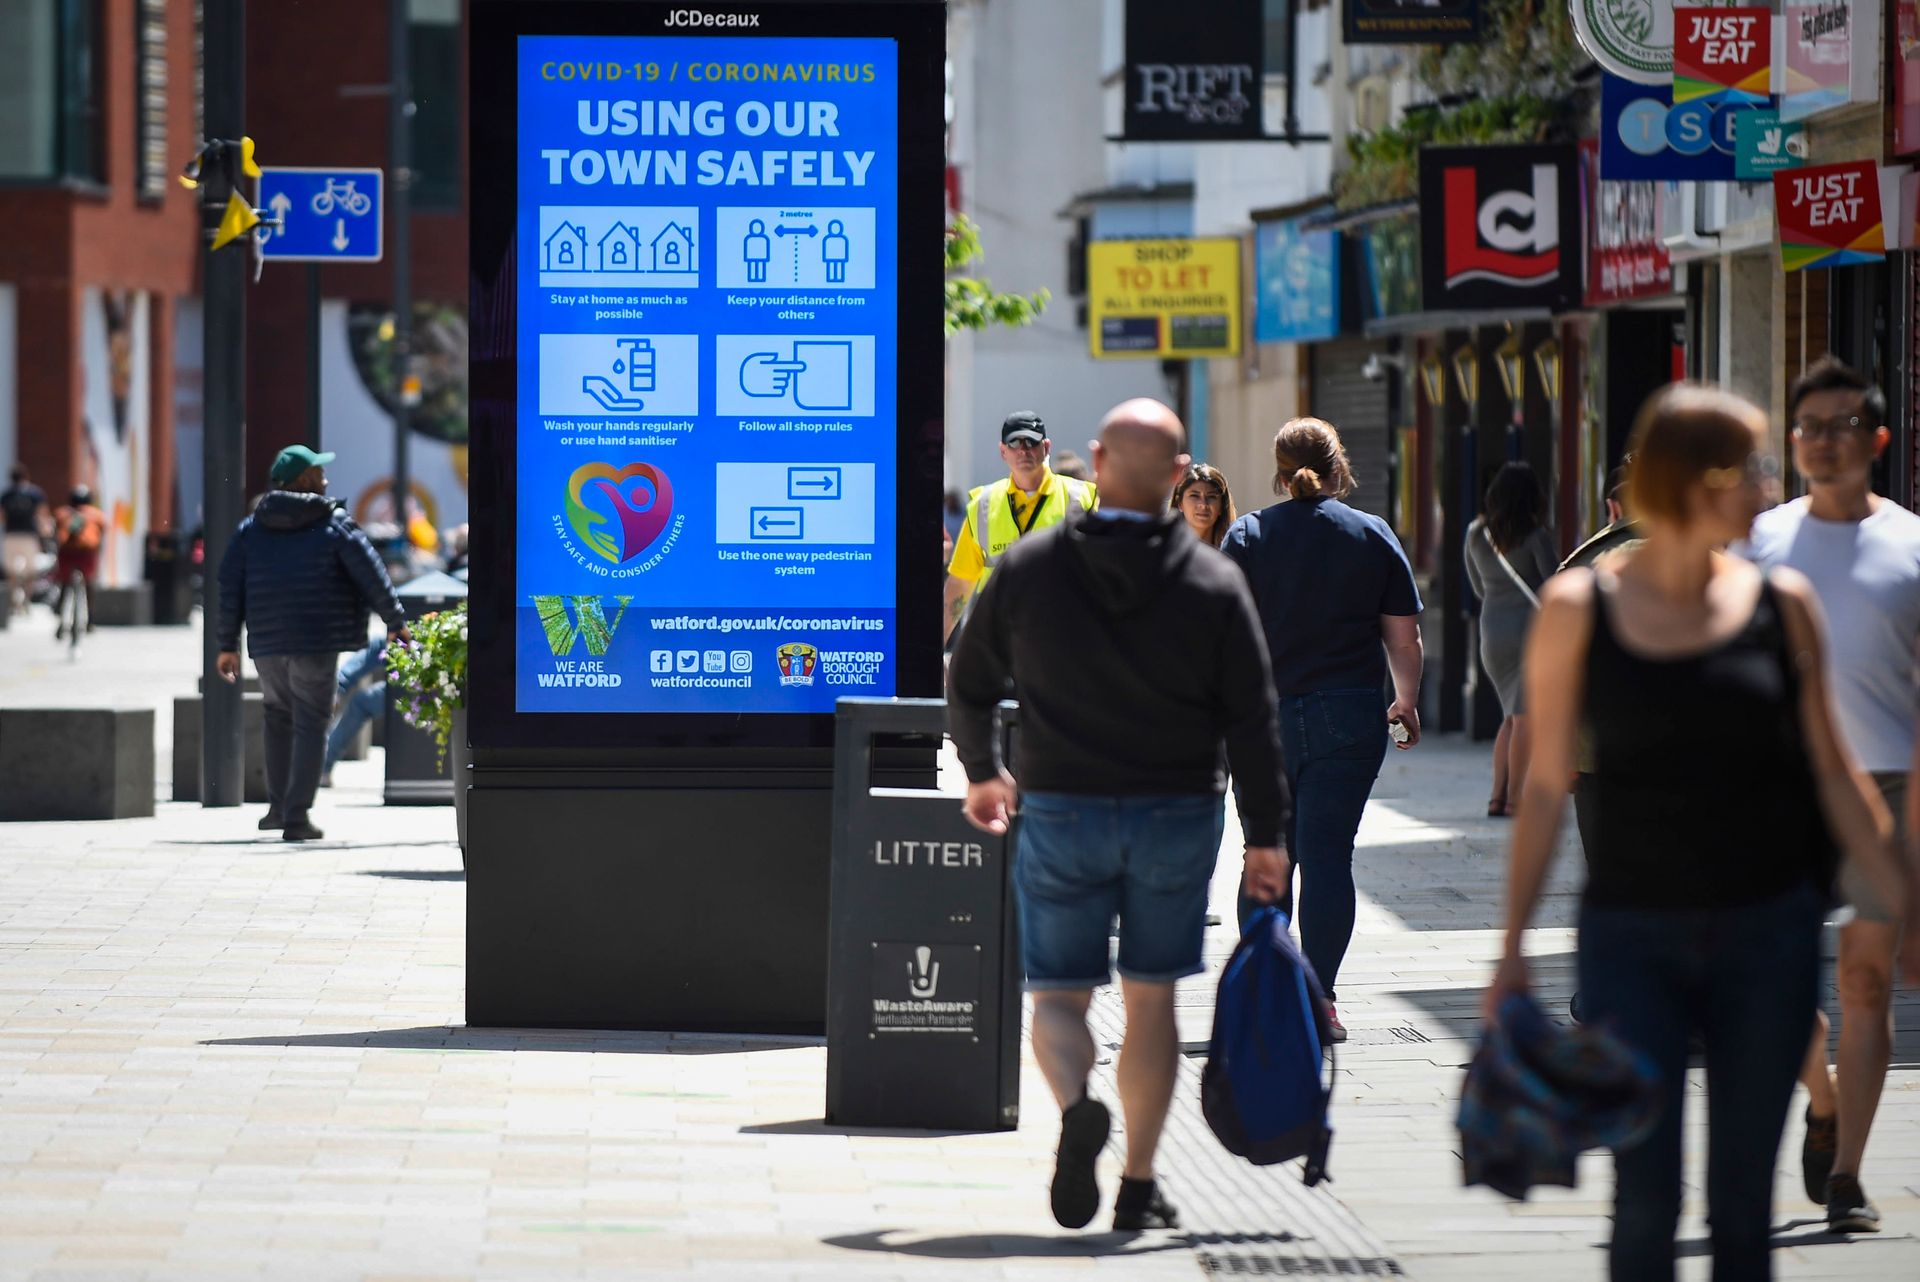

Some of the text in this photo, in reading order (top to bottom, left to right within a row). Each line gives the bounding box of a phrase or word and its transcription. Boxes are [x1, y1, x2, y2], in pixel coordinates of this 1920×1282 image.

[664, 10, 760, 27] JCDecaux
[1688, 16, 1756, 43] JUST
[1702, 41, 1756, 64] EAT
[541, 62, 875, 82] COVID-19 / CORONAVIRUS
[1136, 64, 1252, 112] RIFT
[577, 100, 839, 137] USING OUR
[541, 149, 876, 186] TOWN SAFELY
[1792, 172, 1862, 207] JUST
[1809, 198, 1864, 228] EAT
[1136, 246, 1193, 262] SHOP
[1114, 264, 1214, 292] TO LET
[550, 294, 688, 307] Stay at home as much as
[727, 295, 866, 308] Keep your distance from
[595, 309, 644, 321] possible
[777, 310, 815, 320] others
[543, 420, 694, 433] Wash your hands regularly
[738, 421, 853, 434] Follow all shop rules
[560, 435, 677, 446] or use hand sanitiser
[552, 514, 685, 578] STAY SAFE AND CONSIDER OTHERS
[992, 542, 1012, 552] S01
[718, 550, 872, 563] Use the one way pedestrian
[774, 565, 815, 575] system
[651, 616, 884, 633] watford.gov.uk/coronavirus
[707, 652, 722, 661] You
[819, 651, 884, 662] WATFORD
[555, 661, 604, 672] WE ARE
[706, 663, 723, 672] Tube
[823, 663, 879, 673] BOROUGH
[537, 673, 622, 688] WATFORD
[651, 676, 752, 688] watfordcouncil
[826, 674, 876, 685] COUNCIL
[875, 841, 983, 867] LITTER
[873, 999, 974, 1013] WasteAware
